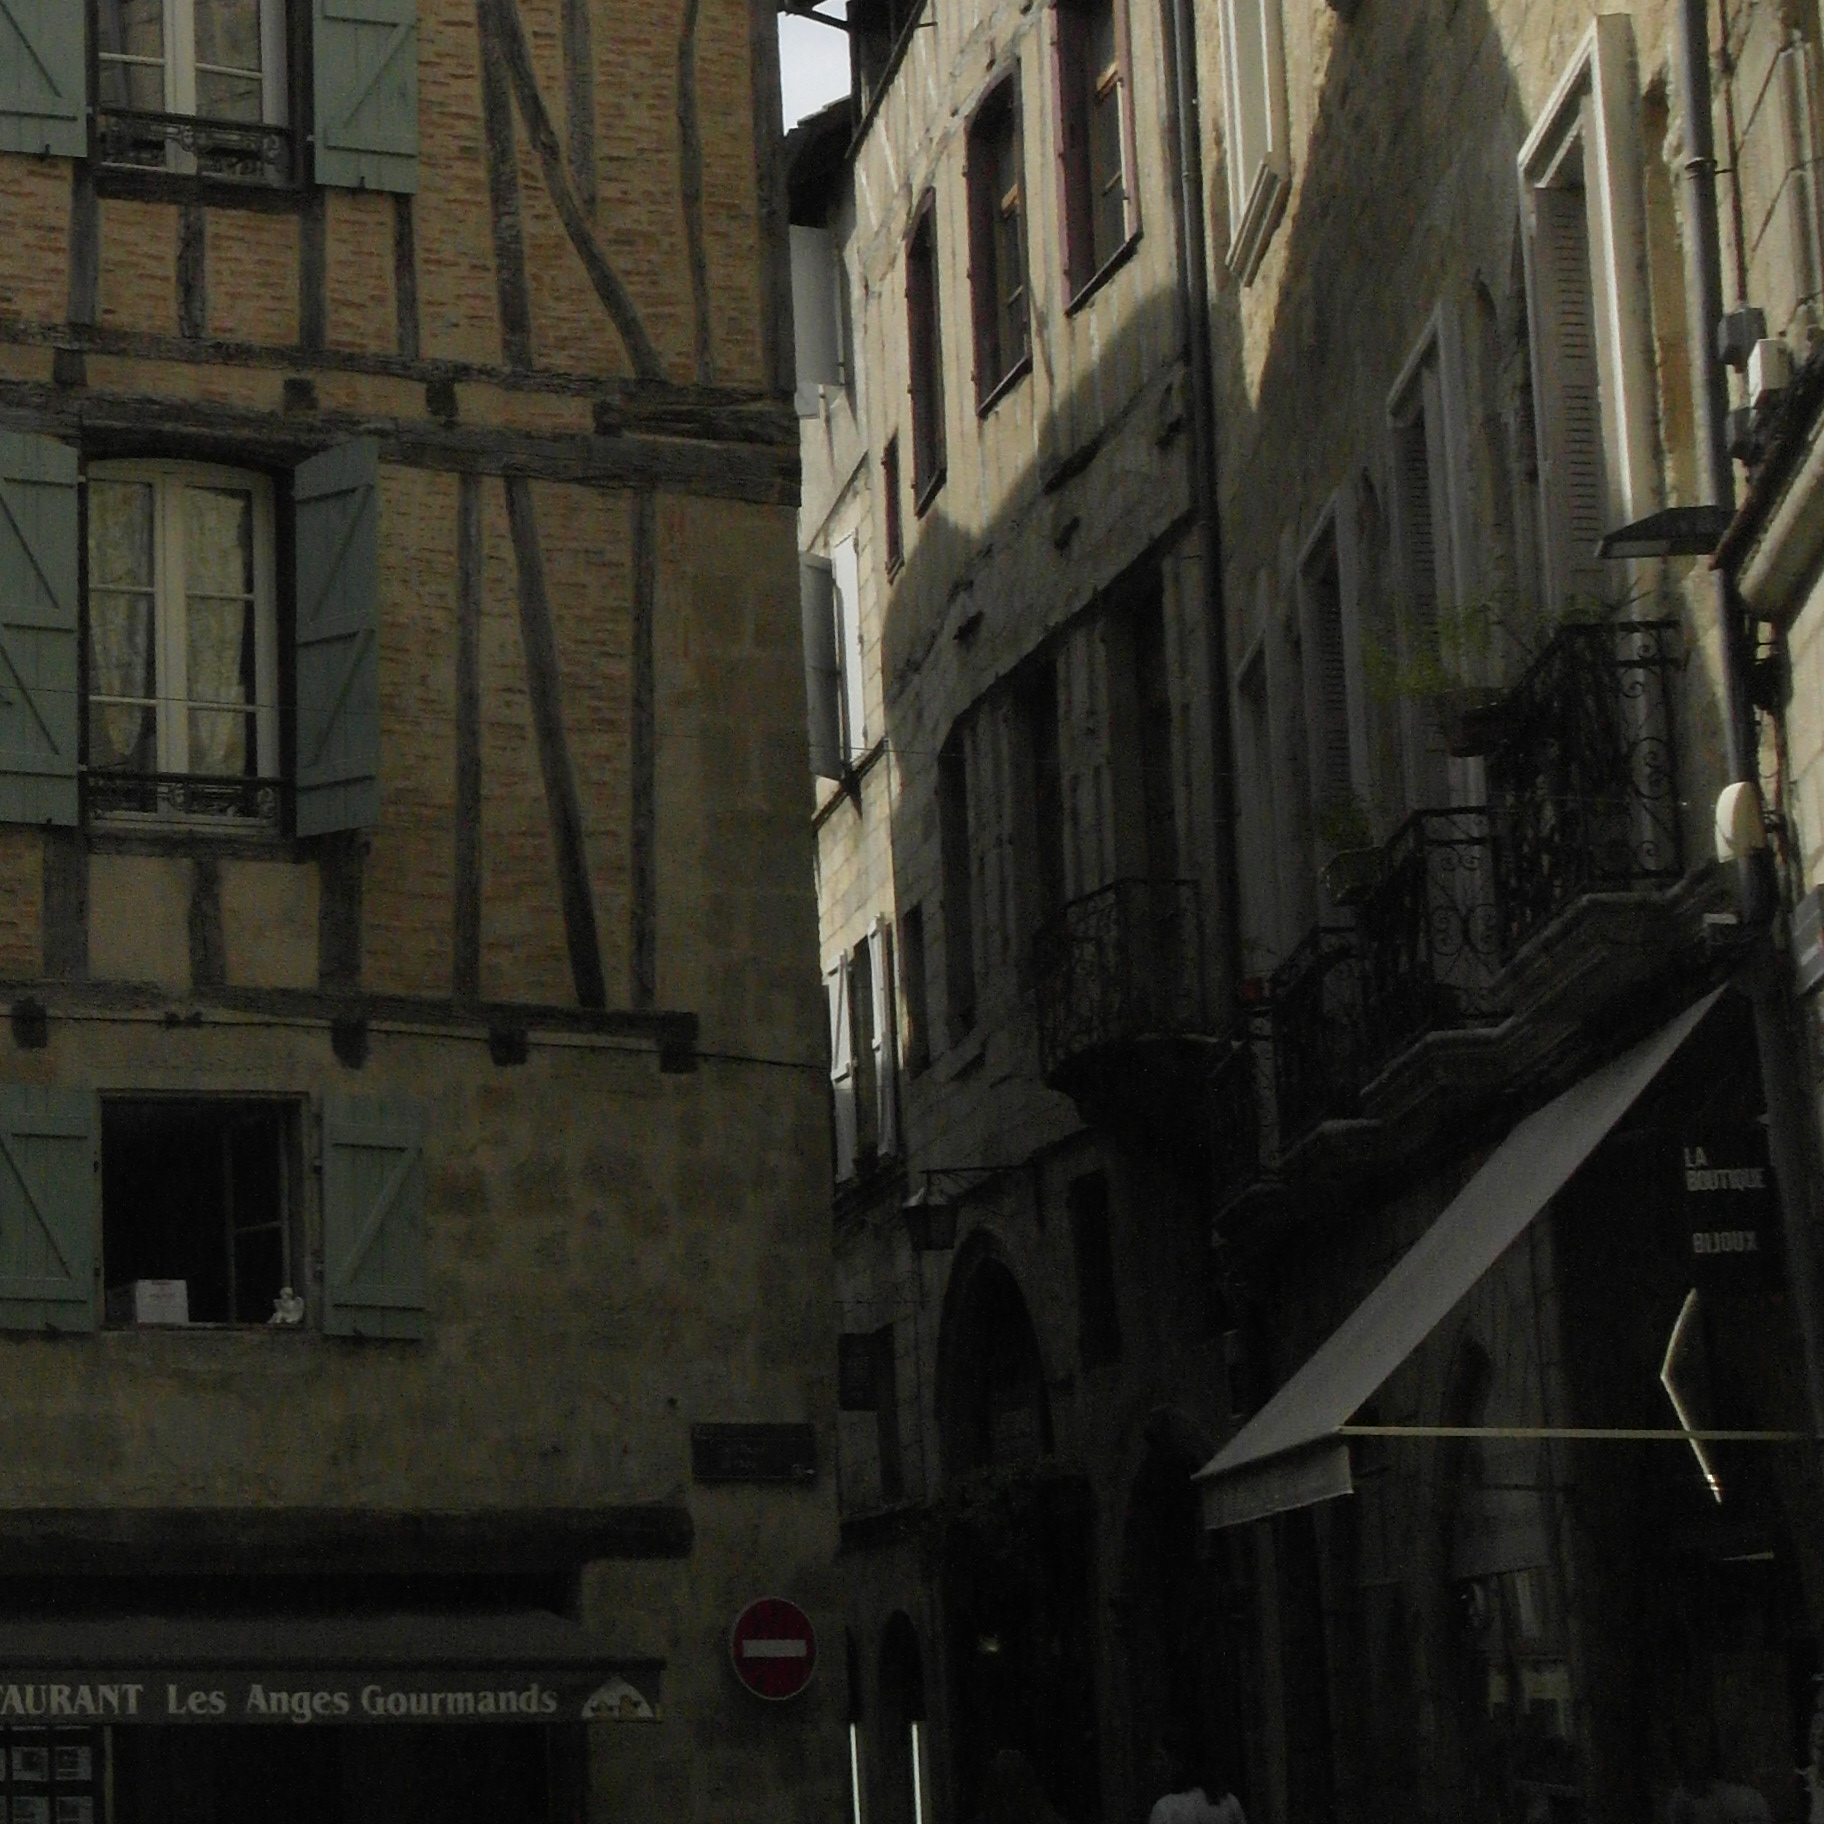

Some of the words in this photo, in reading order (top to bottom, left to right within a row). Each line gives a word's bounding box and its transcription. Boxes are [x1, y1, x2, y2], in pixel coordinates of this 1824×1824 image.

[1683, 1145, 1709, 1169] LA
[1685, 1167, 1767, 1192] BOUTIQUE
[1692, 1230, 1759, 1254] BIJOUX
[166, 1682, 227, 1716] Les
[245, 1683, 351, 1725] Anges
[360, 1682, 559, 1717] Gourmands
